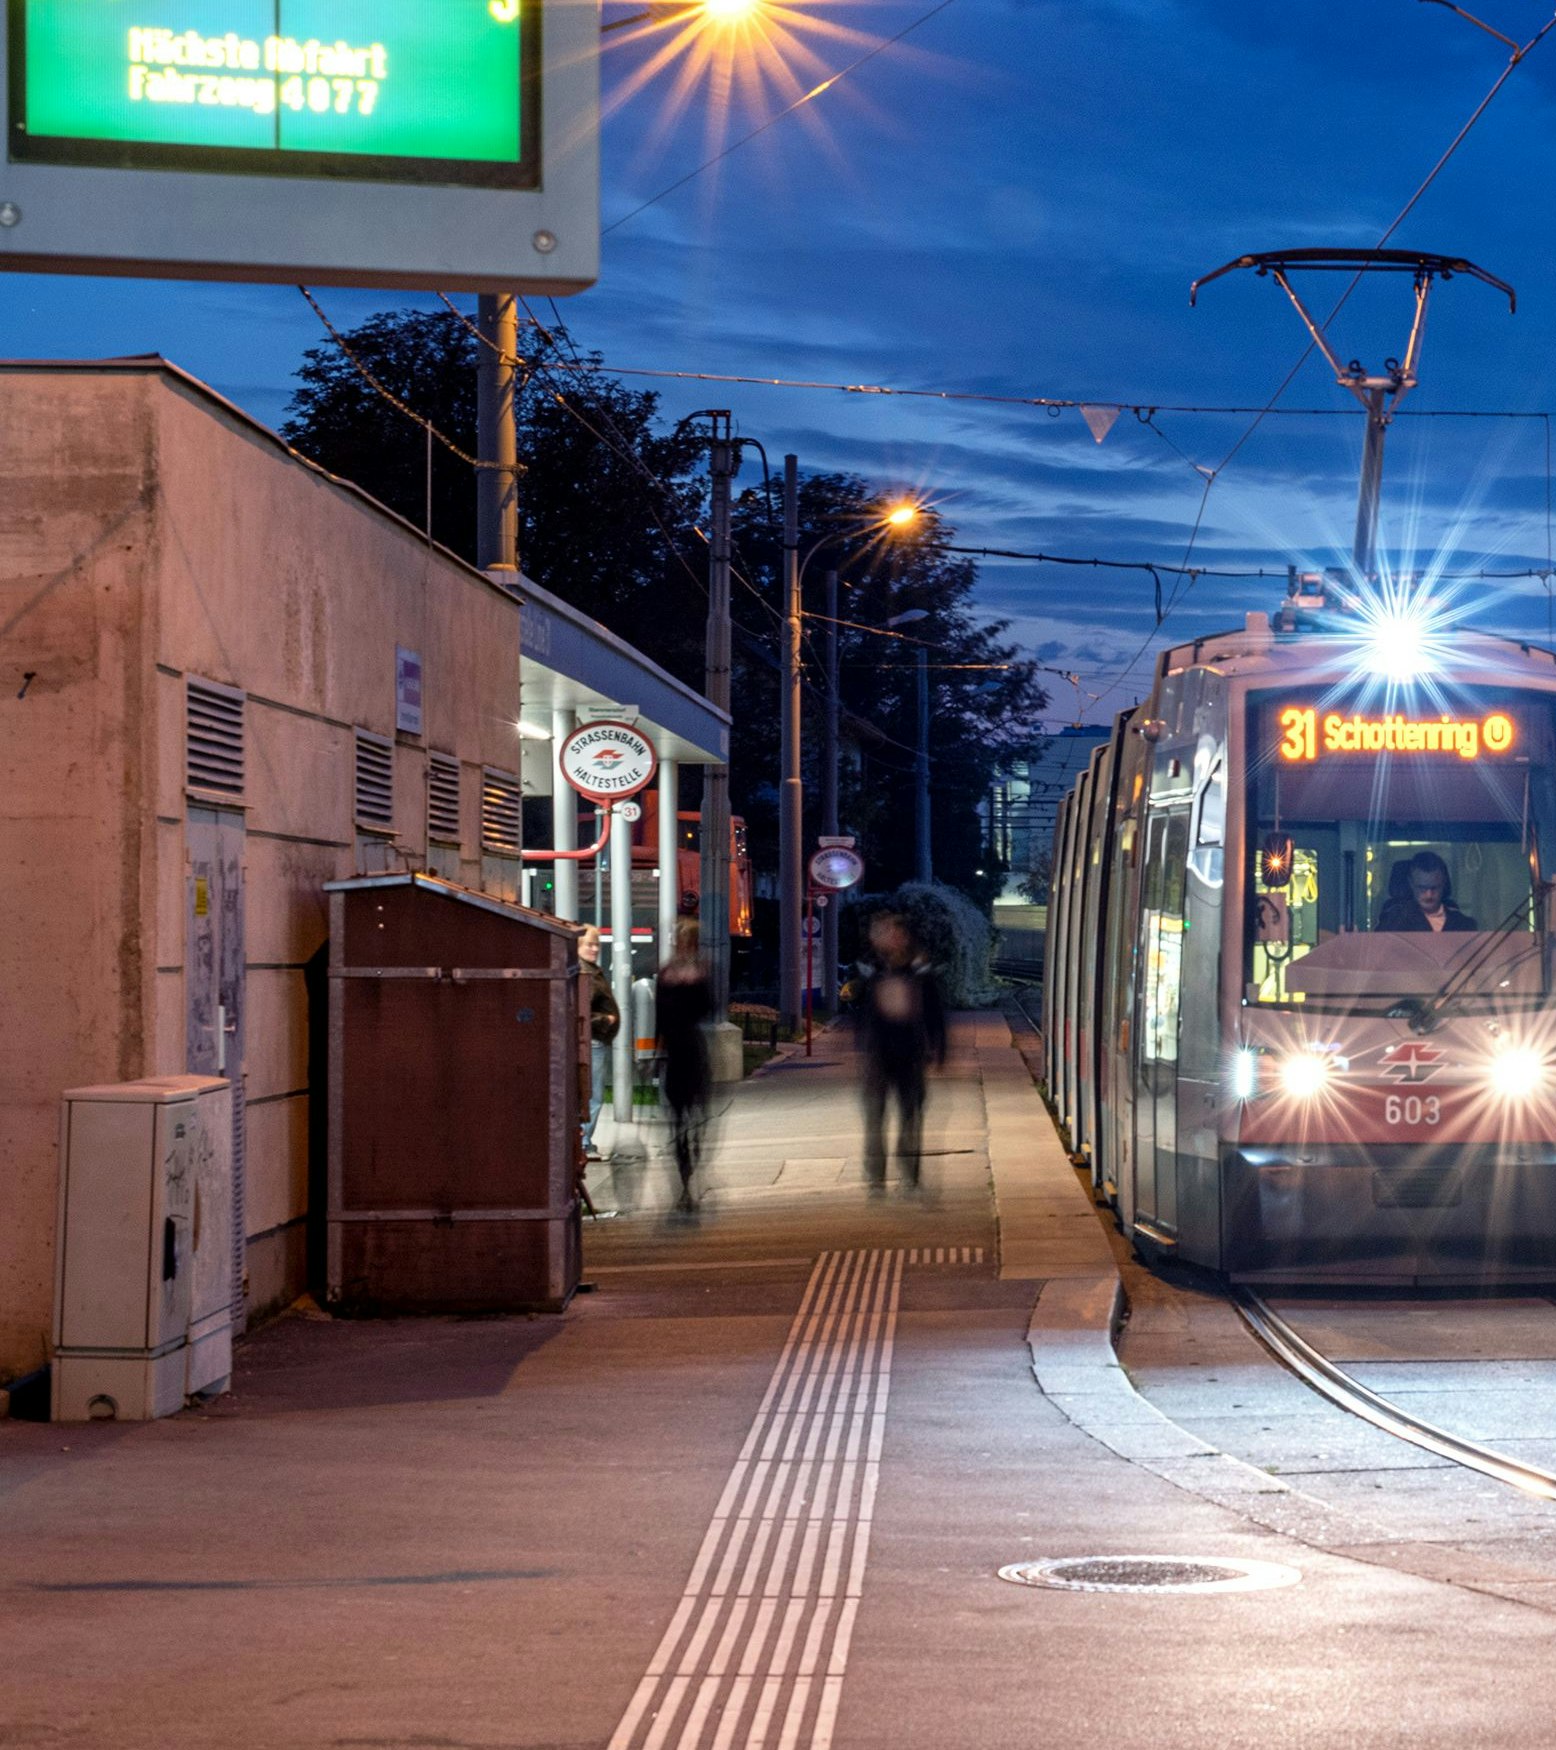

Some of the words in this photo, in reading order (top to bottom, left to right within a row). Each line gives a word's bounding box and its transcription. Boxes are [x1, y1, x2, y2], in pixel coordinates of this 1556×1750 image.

[128, 64, 276, 114] Fahrzeug
[571, 729, 647, 757] STRASSENBAHN
[1281, 709, 1315, 759] 31
[1323, 715, 1478, 758] Schottenring
[573, 766, 642, 789] HALTESTELLE
[624, 806, 637, 817] 31
[1385, 1095, 1440, 1125] 603
